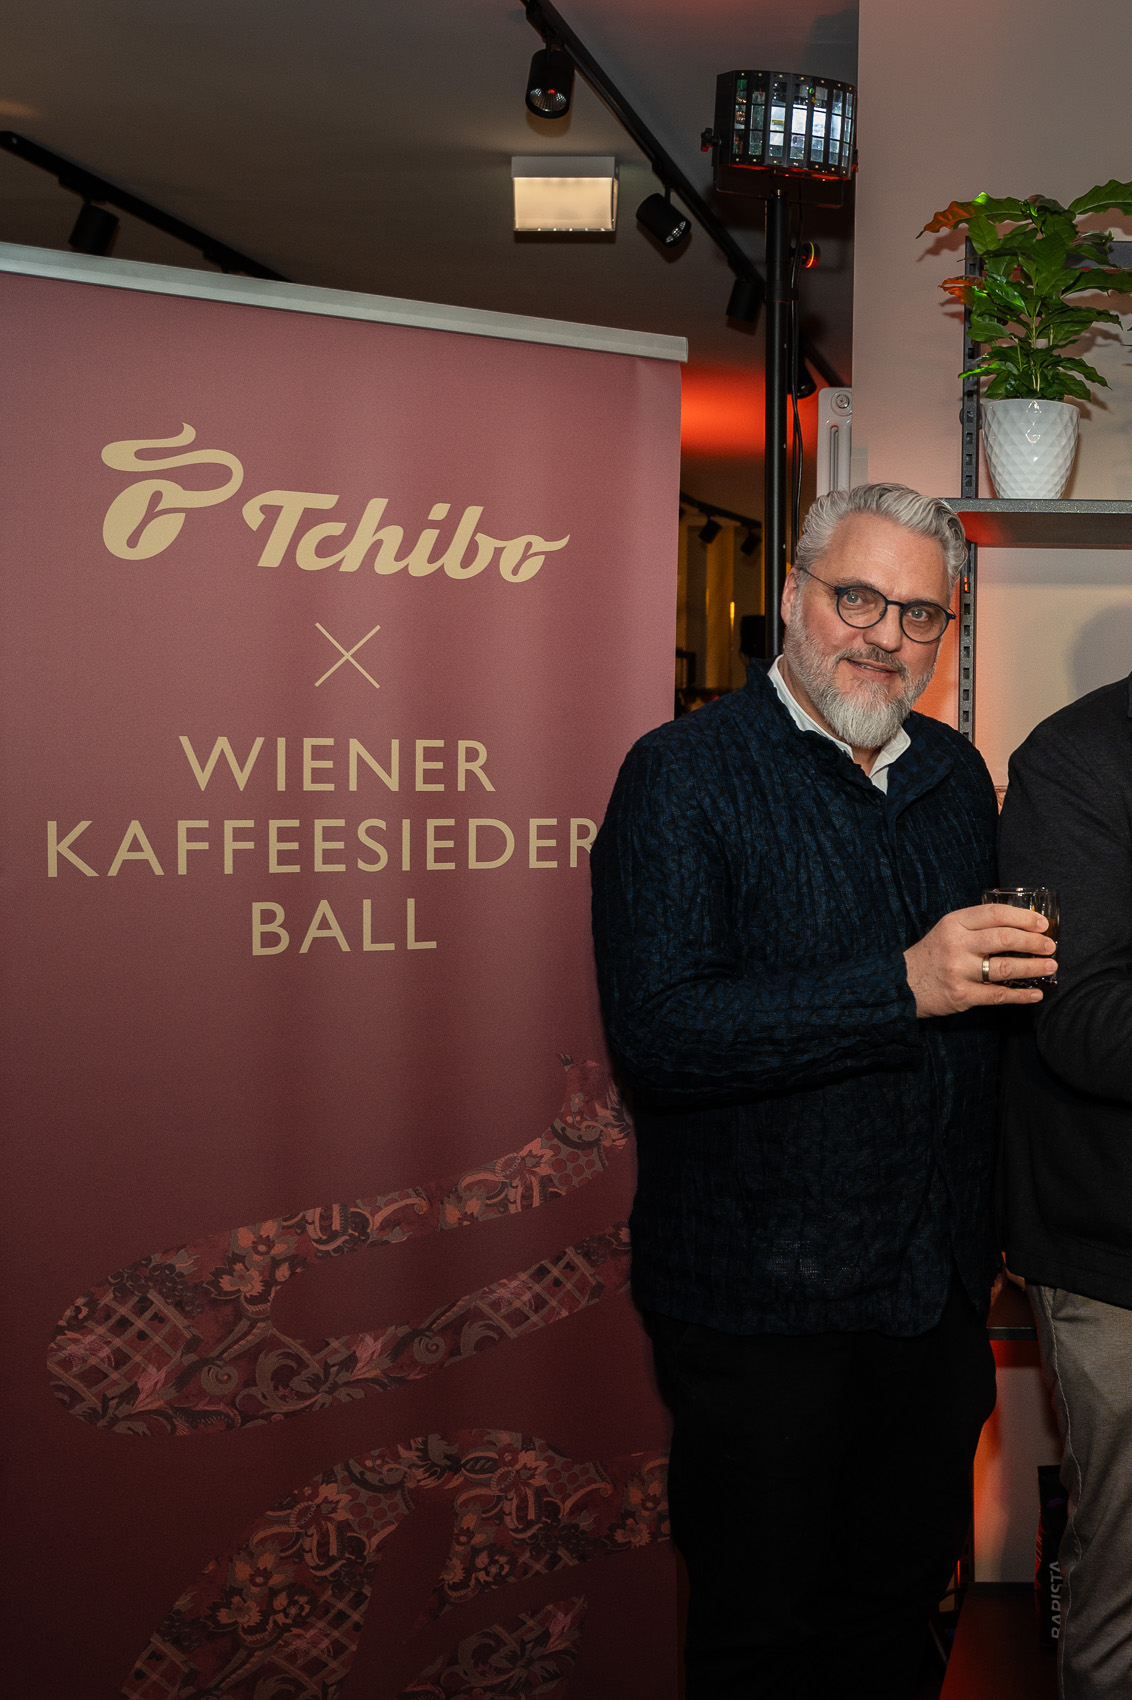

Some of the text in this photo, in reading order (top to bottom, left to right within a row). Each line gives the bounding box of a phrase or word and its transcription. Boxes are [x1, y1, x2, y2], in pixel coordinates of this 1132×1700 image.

[242, 489, 570, 583] Tchibo
[178, 735, 496, 792] WIENER
[46, 817, 598, 878] KAFFEESIEDER
[251, 898, 437, 956] BALL
